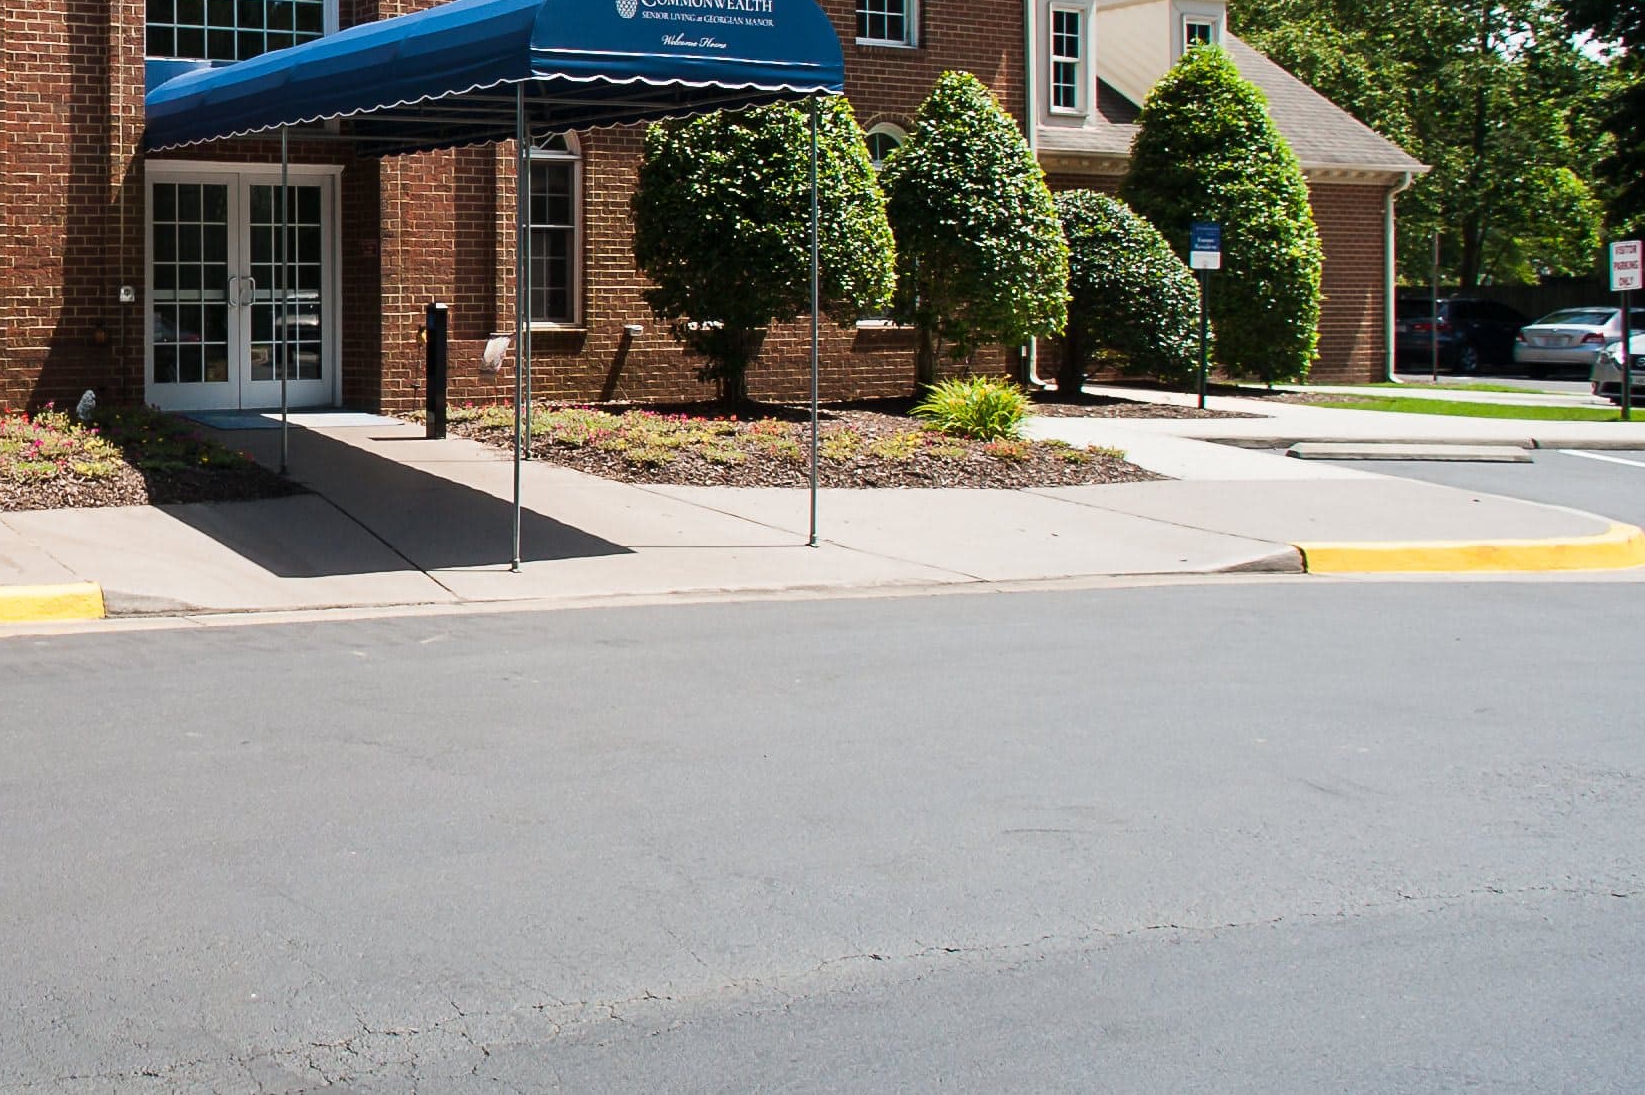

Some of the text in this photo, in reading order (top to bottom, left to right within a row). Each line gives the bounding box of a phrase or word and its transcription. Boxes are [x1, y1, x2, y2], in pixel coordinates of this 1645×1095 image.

[642, 11, 669, 20] SENIOR
[670, 12, 696, 22] LIVING
[703, 15, 744, 25] GEORGIAN
[745, 17, 774, 27] MANOR
[661, 32, 727, 49] Welcome Home
[1615, 245, 1637, 254] VISITOR
[1614, 261, 1638, 270] PARKING
[1619, 277, 1633, 286] ONLY
